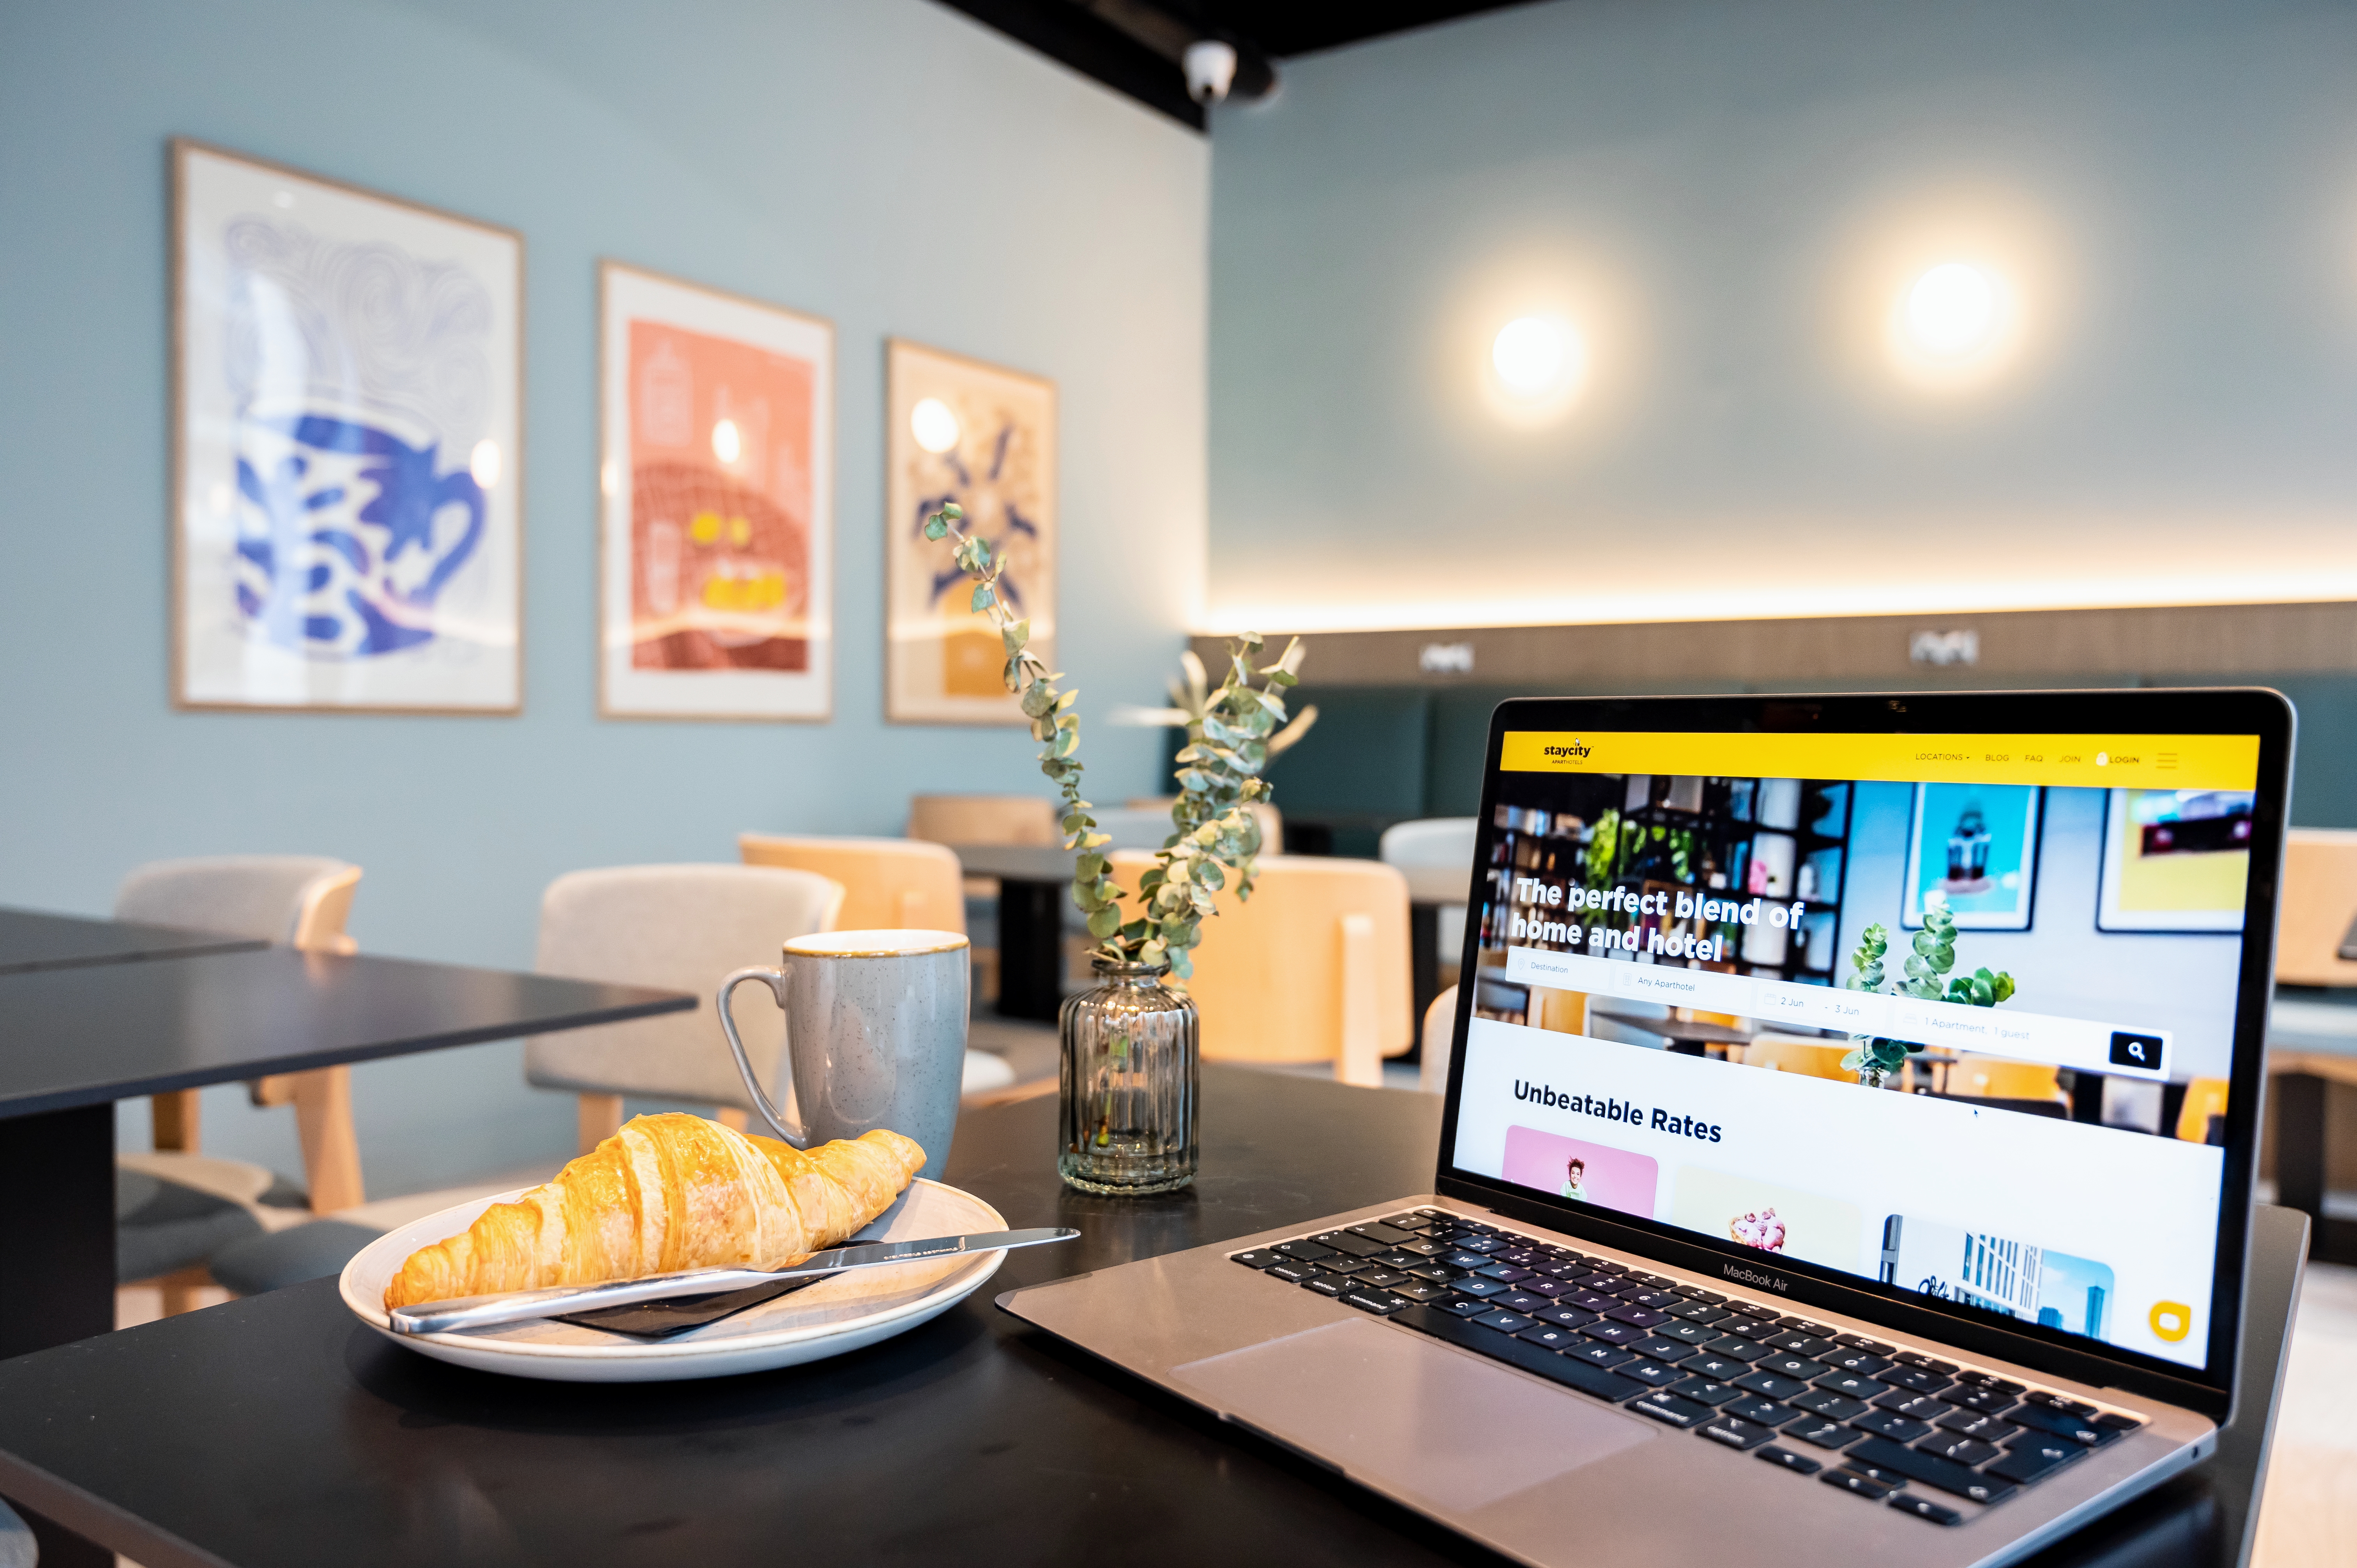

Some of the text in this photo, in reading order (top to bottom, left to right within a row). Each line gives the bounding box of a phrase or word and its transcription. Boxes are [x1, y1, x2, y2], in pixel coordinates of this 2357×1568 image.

[1544, 746, 1591, 758] staycity
[2025, 754, 2044, 762] FAQ
[2110, 756, 2140, 764] LOGIN
[1517, 878, 1804, 929] The perfect blend of
[1511, 913, 1723, 962] home and hotel
[1531, 962, 1568, 974] Destination
[1638, 976, 1695, 991] Any Aparthotel
[1788, 998, 1804, 1008] Jun
[1843, 1006, 1859, 1016] Jun
[1932, 1019, 1987, 1035] Apartment,
[2001, 1030, 2029, 1041] guest
[1514, 1079, 1722, 1142] Unbeatable Rates
[1275, 1267, 1301, 1277] control
[1724, 1263, 1788, 1291] MacBook Air
[1313, 1281, 1336, 1291] option
[1348, 1295, 1388, 1310] command
[1641, 1367, 1660, 1376] M
[1706, 1362, 1723, 1370] K
